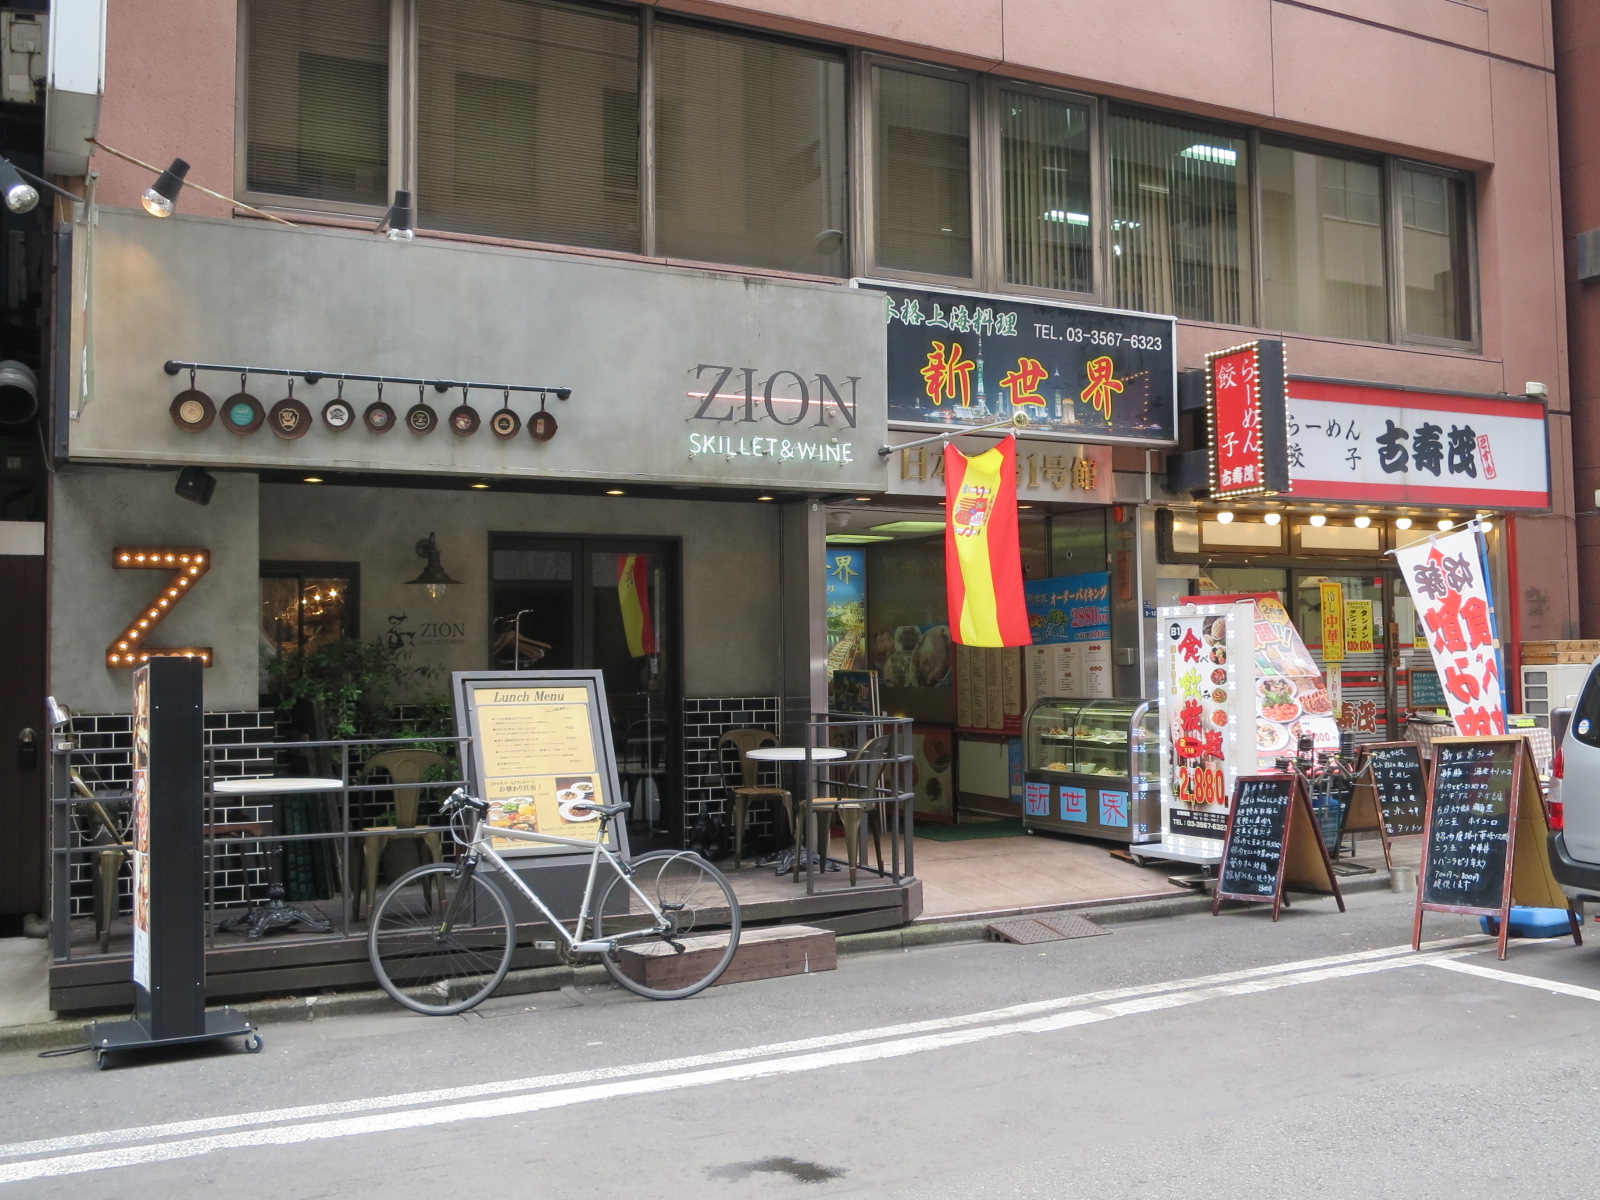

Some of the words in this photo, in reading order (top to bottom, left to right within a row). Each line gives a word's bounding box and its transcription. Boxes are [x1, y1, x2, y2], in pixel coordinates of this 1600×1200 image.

[694, 364, 861, 428] ZION
[920, 341, 1124, 420] 新世界
[1241, 359, 1259, 454] らーめん
[1217, 362, 1239, 457] 餃子
[689, 433, 854, 463] SKILLET&WINE
[106, 547, 213, 669] Z
[1050, 585, 1108, 605] オーダーバイキング
[1326, 590, 1339, 645] 冷し中華
[421, 623, 465, 637] ZION
[1170, 627, 1180, 636] B1
[494, 691, 530, 703] Lunch
[534, 690, 565, 702] Menu
